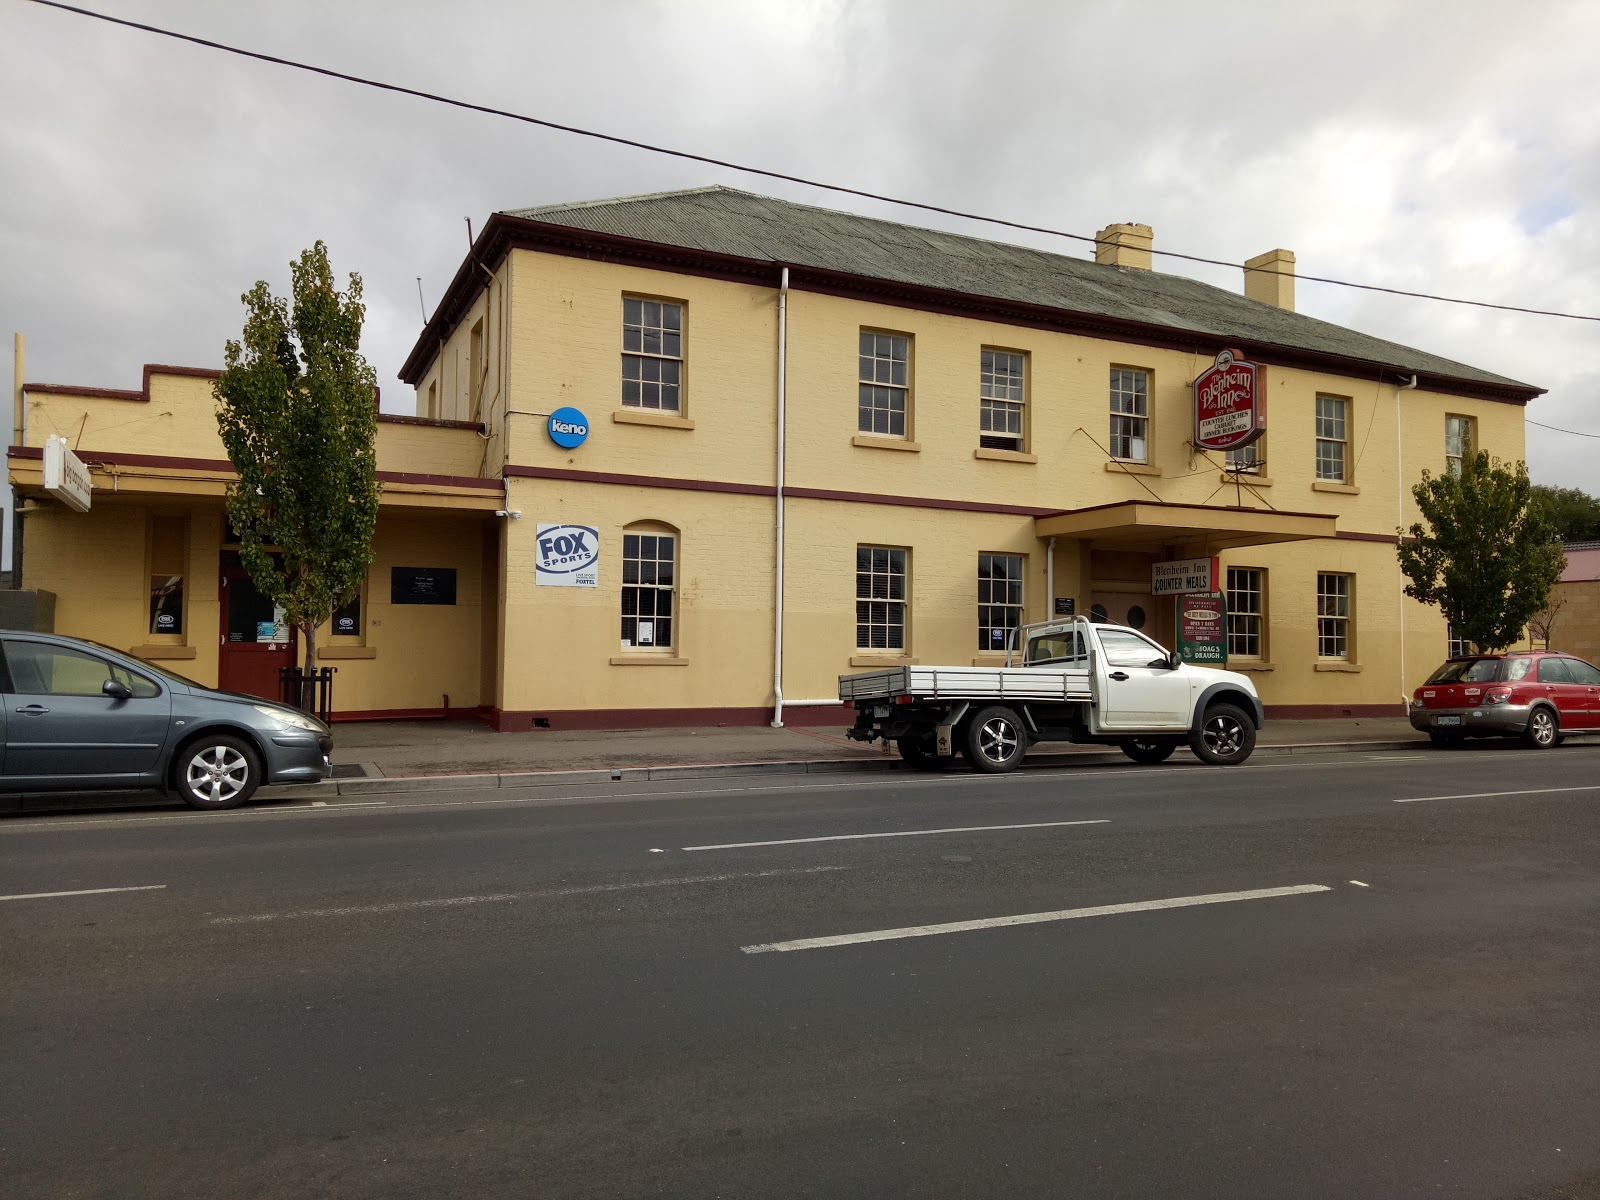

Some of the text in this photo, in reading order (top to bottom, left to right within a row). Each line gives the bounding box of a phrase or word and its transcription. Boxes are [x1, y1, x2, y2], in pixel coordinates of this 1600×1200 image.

[1200, 370, 1251, 410] Blenheim
[1217, 390, 1235, 409] Inn
[1202, 410, 1249, 427] COUNTER LUNCHES
[552, 419, 587, 436] keno
[1204, 424, 1247, 438] DINNER BOOKINGS
[539, 532, 590, 560] FOX
[544, 552, 591, 567] SPORTS
[1155, 563, 1206, 576] Blenheim Inn
[1155, 576, 1207, 591] COUNTER MEALS
